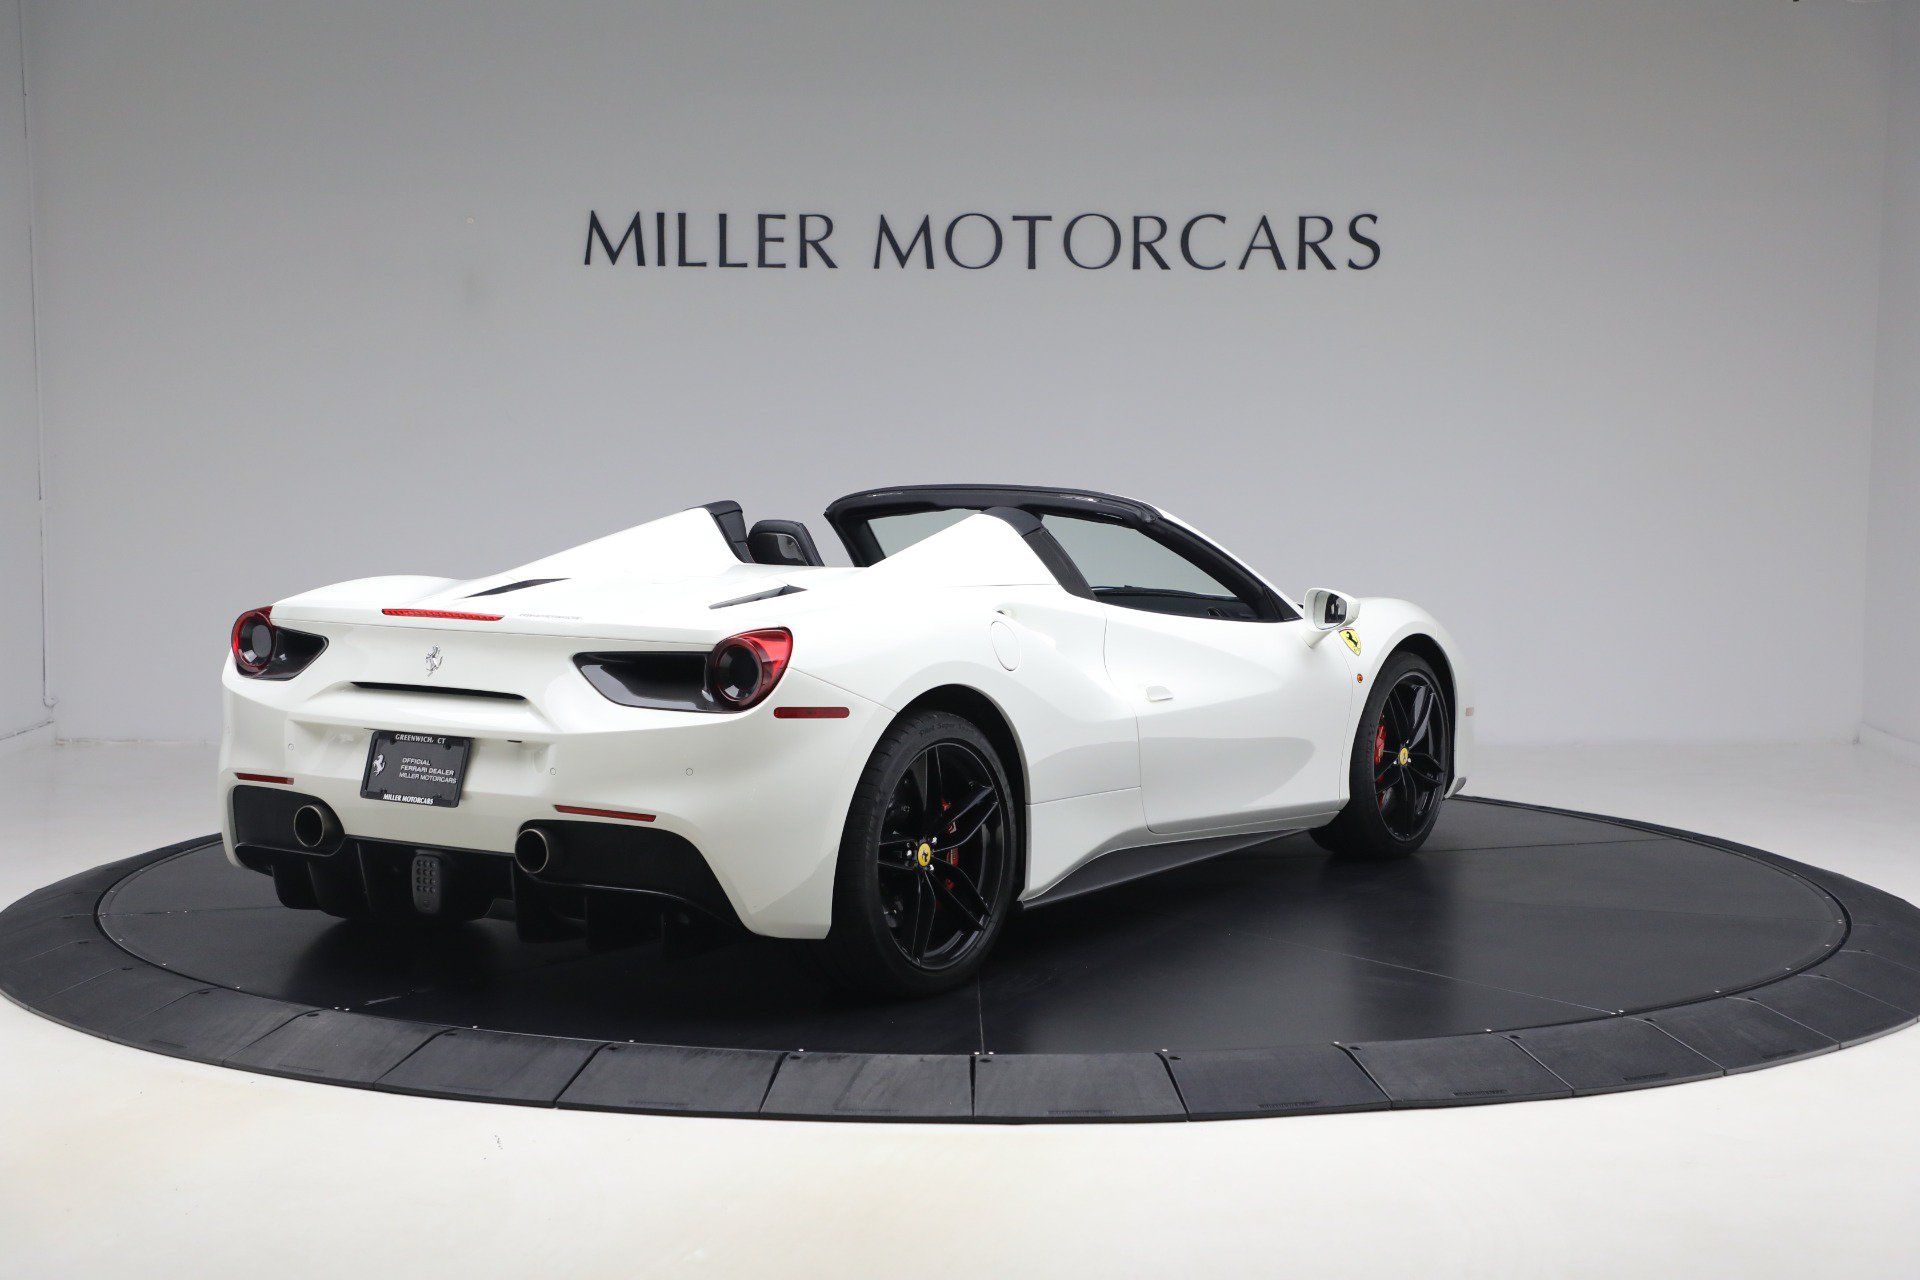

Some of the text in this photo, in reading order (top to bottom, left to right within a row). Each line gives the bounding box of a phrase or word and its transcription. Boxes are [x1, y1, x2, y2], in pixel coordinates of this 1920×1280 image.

[584, 209, 1381, 271] MILLER MOTORCARS
[402, 757, 431, 765] OFFICIAL
[428, 768, 454, 776] DEALER
[399, 772, 457, 784] MILLER MOTORCARS
[383, 793, 434, 804] MILLER MOTORCARS
